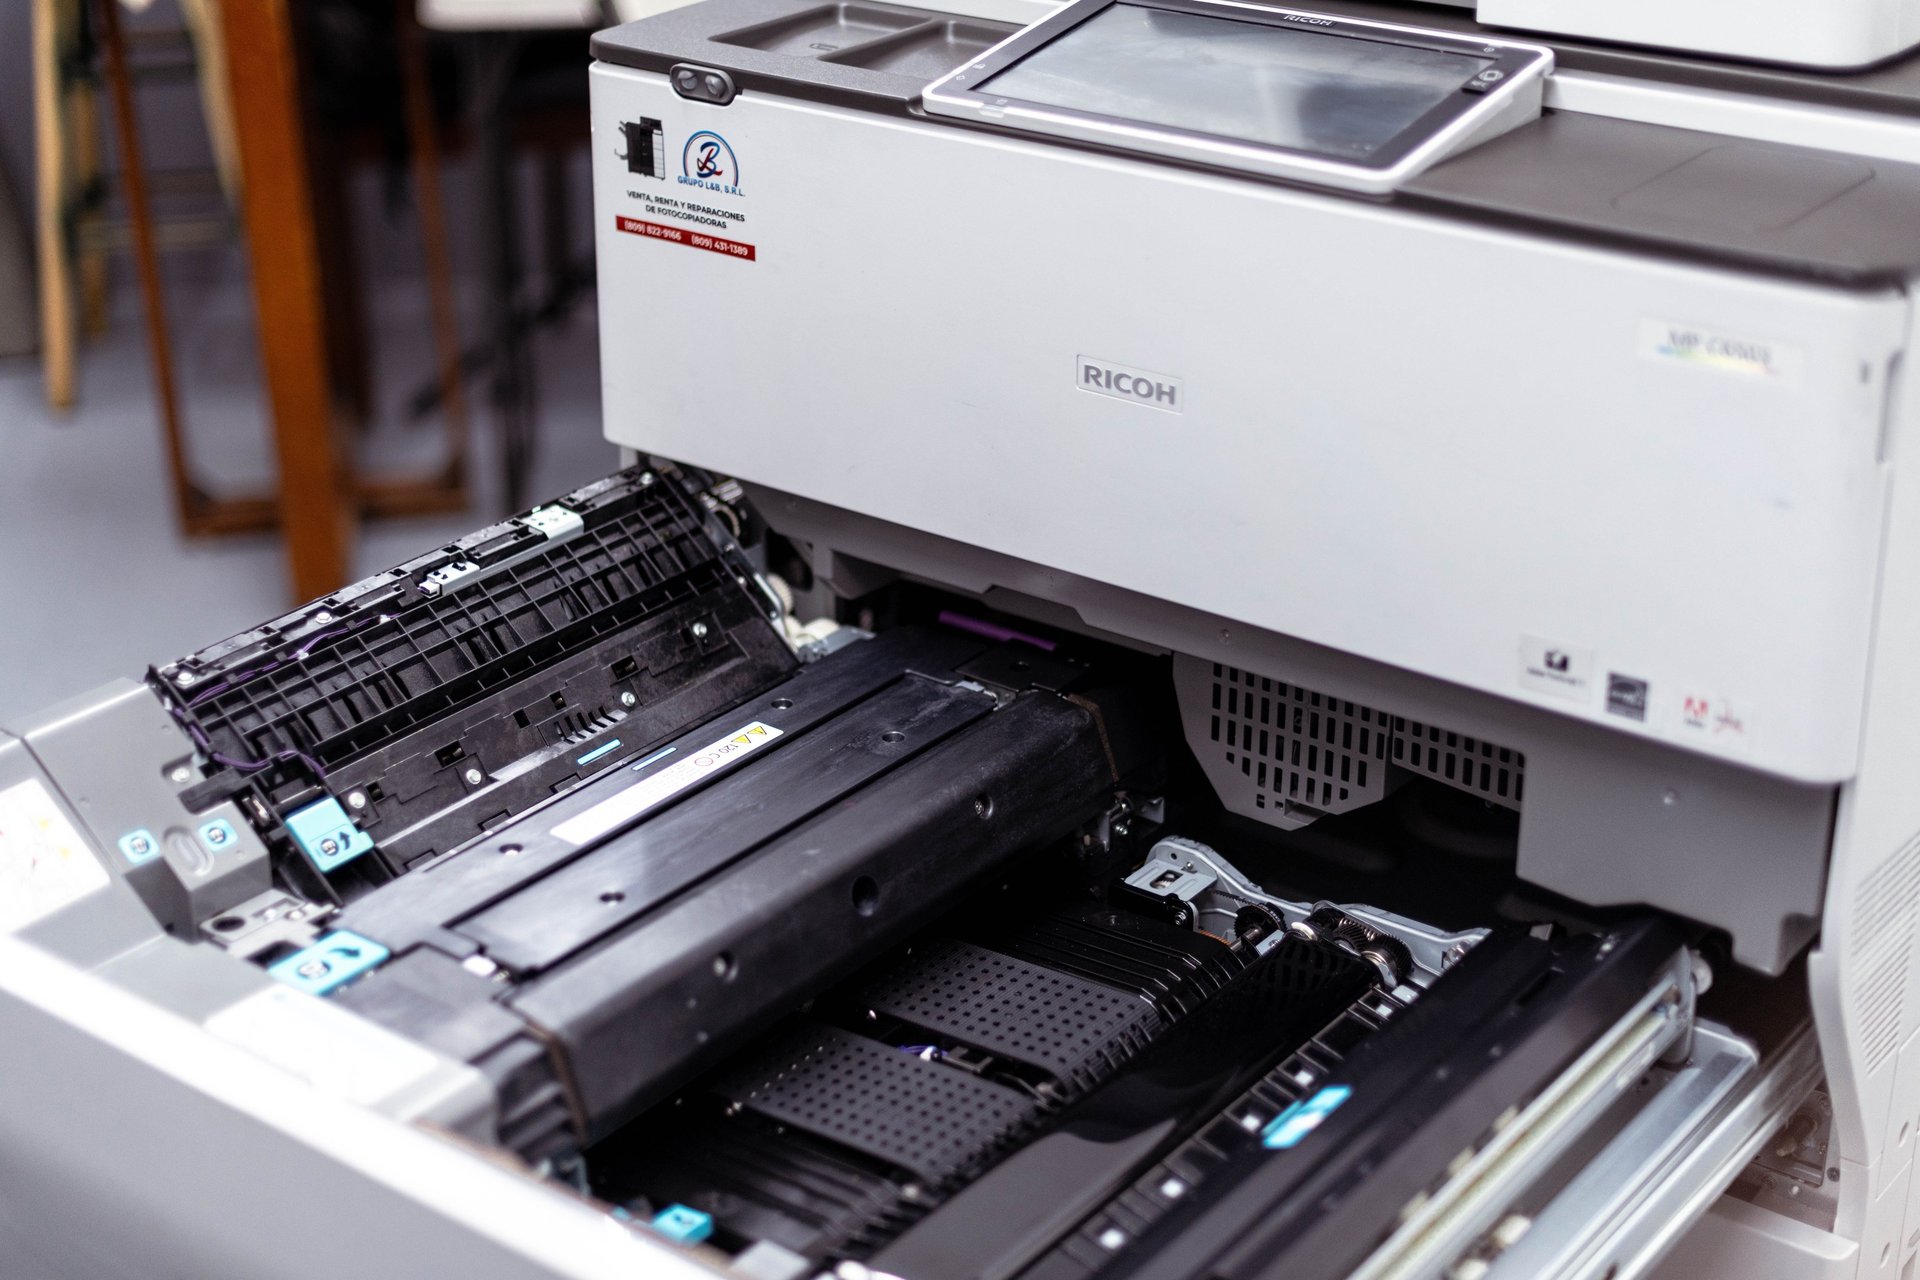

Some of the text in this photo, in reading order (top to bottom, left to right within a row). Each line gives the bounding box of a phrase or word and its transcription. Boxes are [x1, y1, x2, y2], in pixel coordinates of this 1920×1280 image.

[1284, 14, 1332, 26] RICOH
[677, 175, 704, 188] GRUPO
[724, 185, 746, 197] S.R.L.
[626, 190, 745, 222] VENTA, RENTA Y REPARACIONES
[645, 205, 727, 229] DE FOTOCOPIADORAS
[624, 219, 748, 256] (809) 822-9166 (809) 431-1389
[1083, 364, 1176, 405] RICOH
